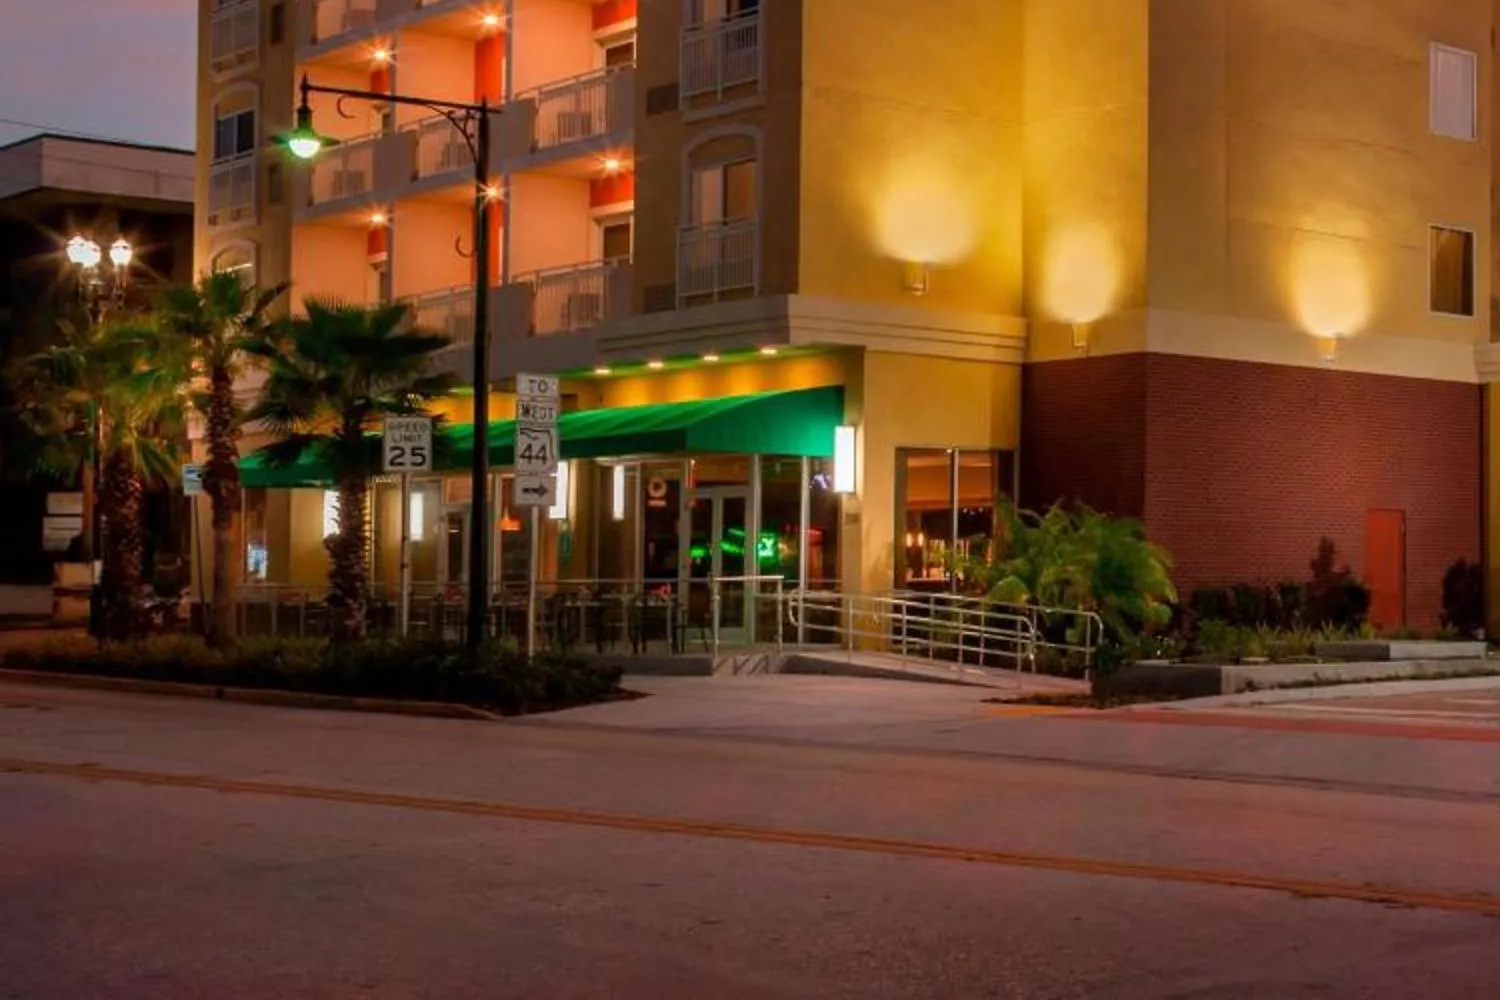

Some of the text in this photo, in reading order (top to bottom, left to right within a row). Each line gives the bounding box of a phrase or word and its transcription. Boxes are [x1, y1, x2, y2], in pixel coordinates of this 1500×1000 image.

[529, 379, 548, 393] TO
[391, 432, 422, 443] LIMIT
[389, 445, 426, 467] 25
[520, 443, 547, 464] 44
